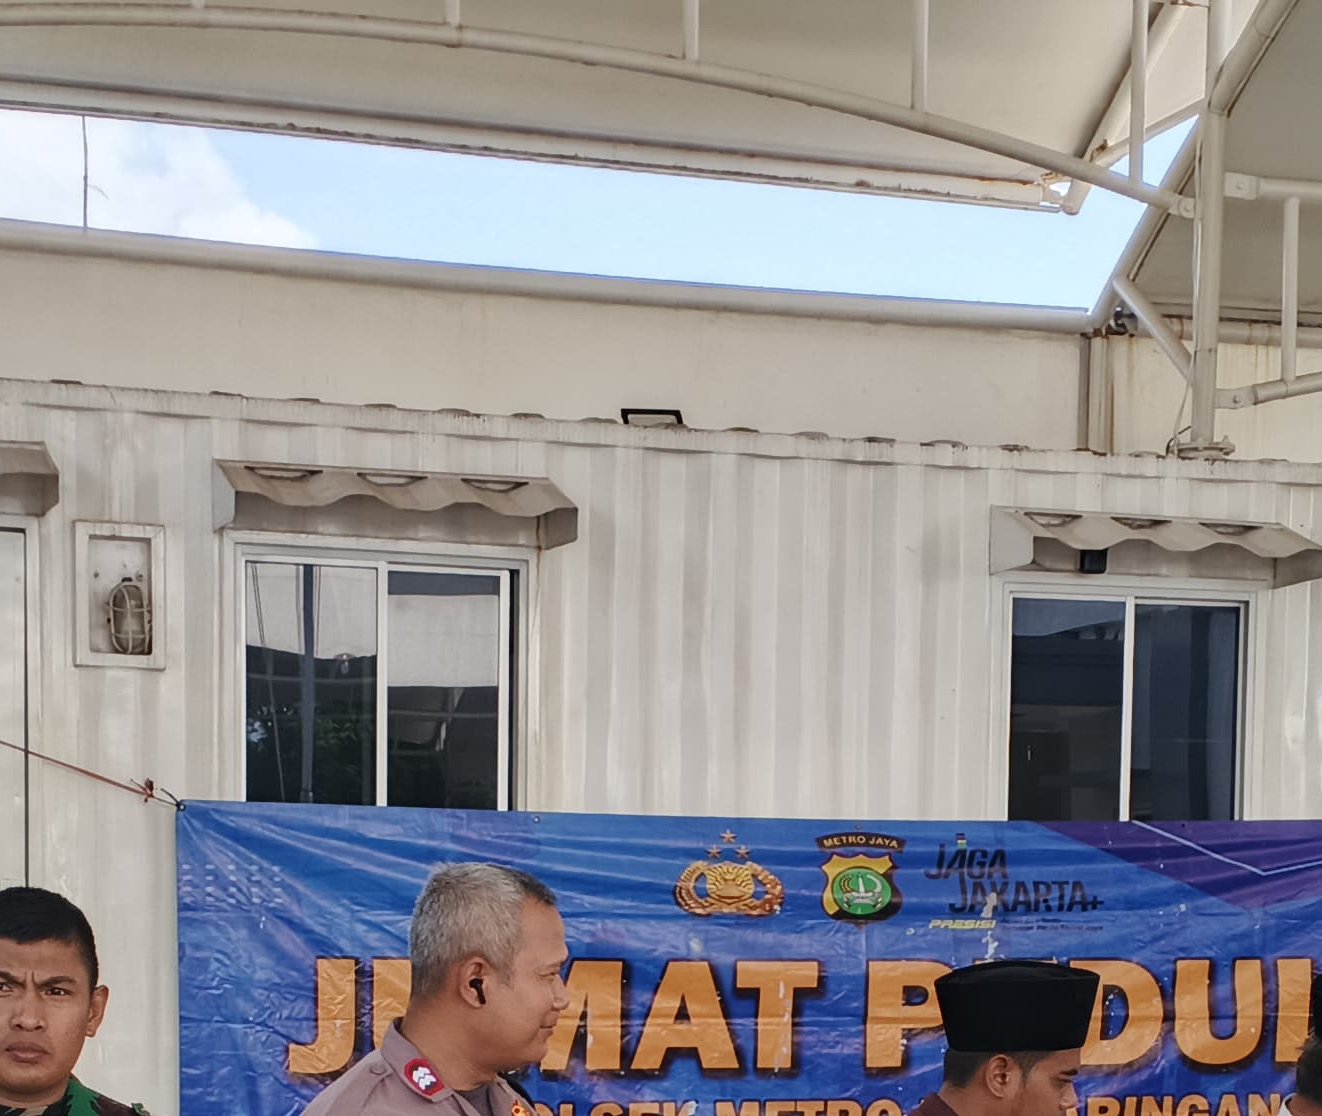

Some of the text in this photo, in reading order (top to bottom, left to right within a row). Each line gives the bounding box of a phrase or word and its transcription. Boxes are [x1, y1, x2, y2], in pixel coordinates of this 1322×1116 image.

[823, 834, 899, 849] METRO JAYA
[924, 842, 1008, 880] JAGA
